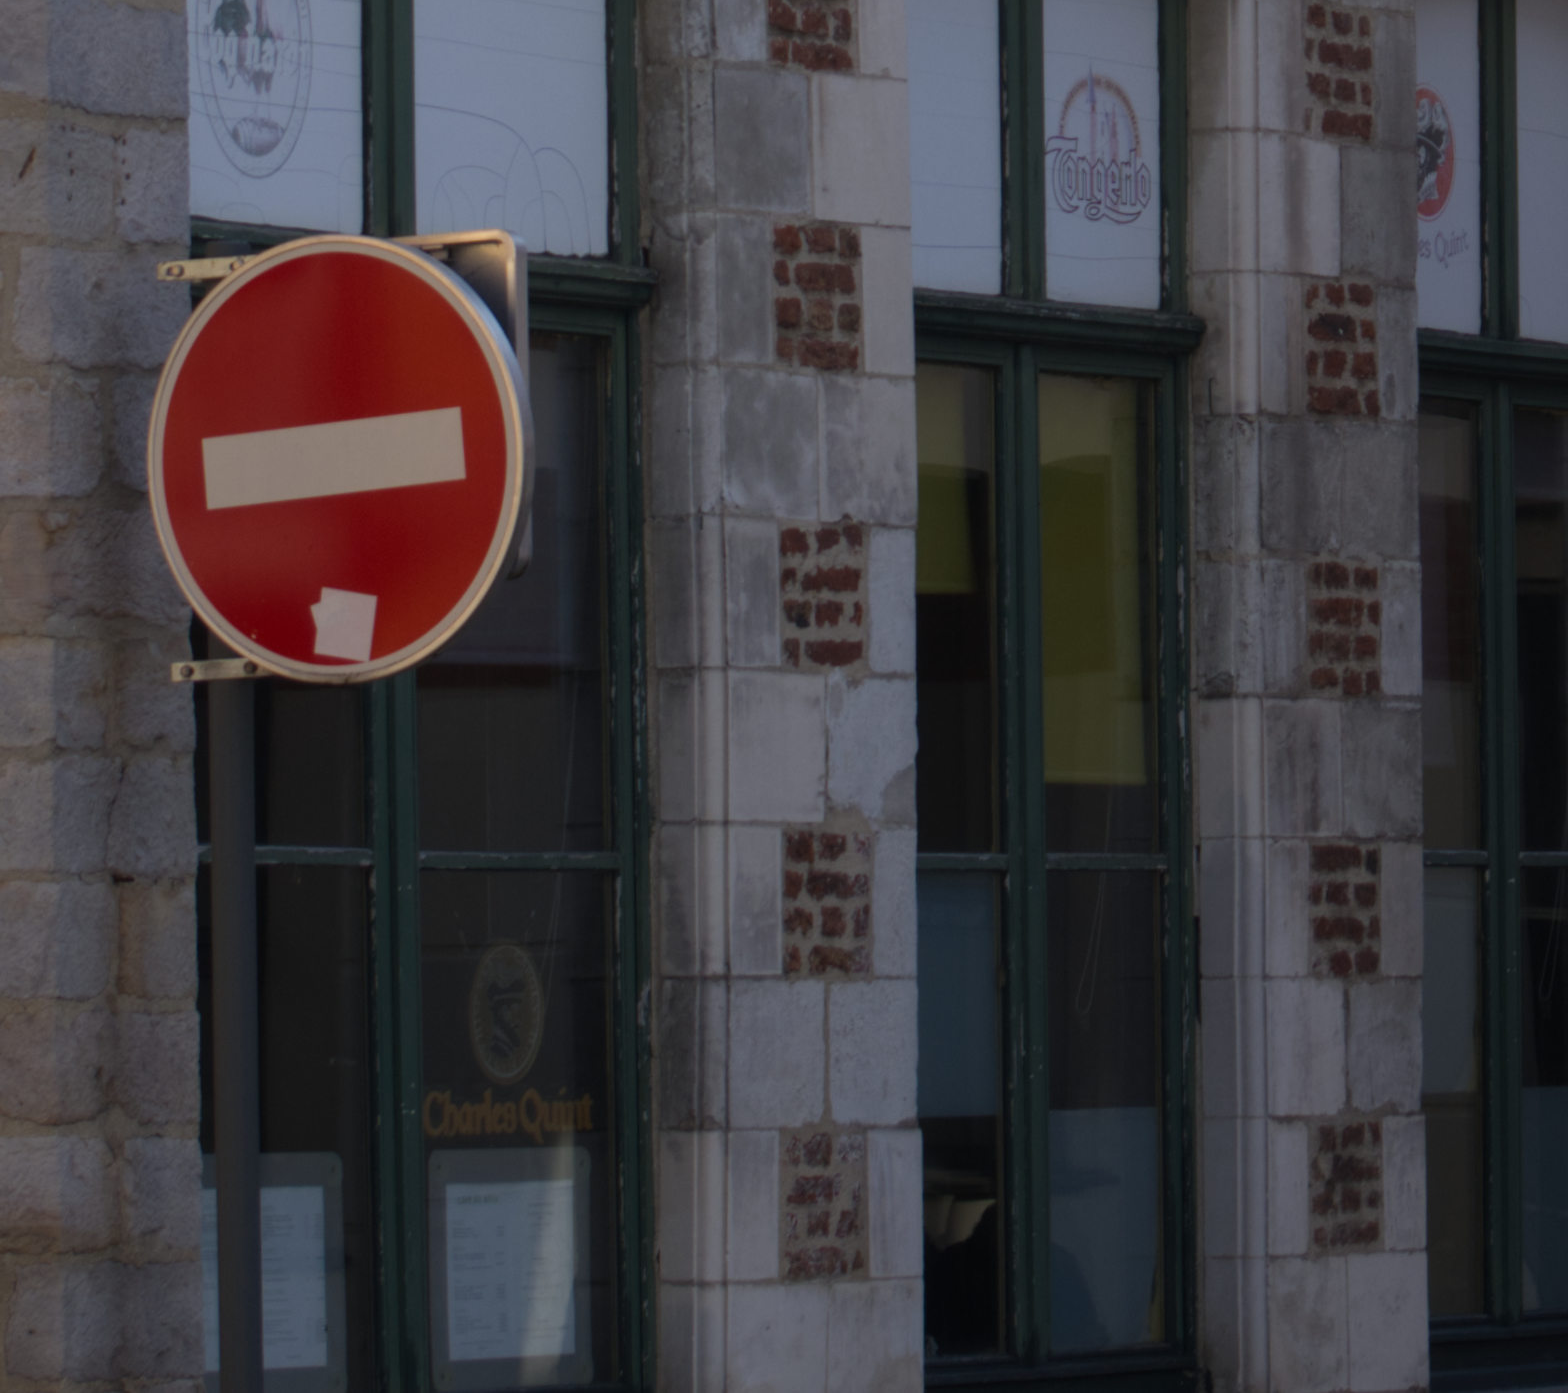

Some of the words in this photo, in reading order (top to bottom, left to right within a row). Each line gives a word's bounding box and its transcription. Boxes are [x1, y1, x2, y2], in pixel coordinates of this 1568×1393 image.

[1044, 135, 1151, 225] Tongerlo
[1434, 229, 1469, 269] Quint
[422, 1087, 518, 1138] Charles
[519, 1086, 593, 1145] Quint
